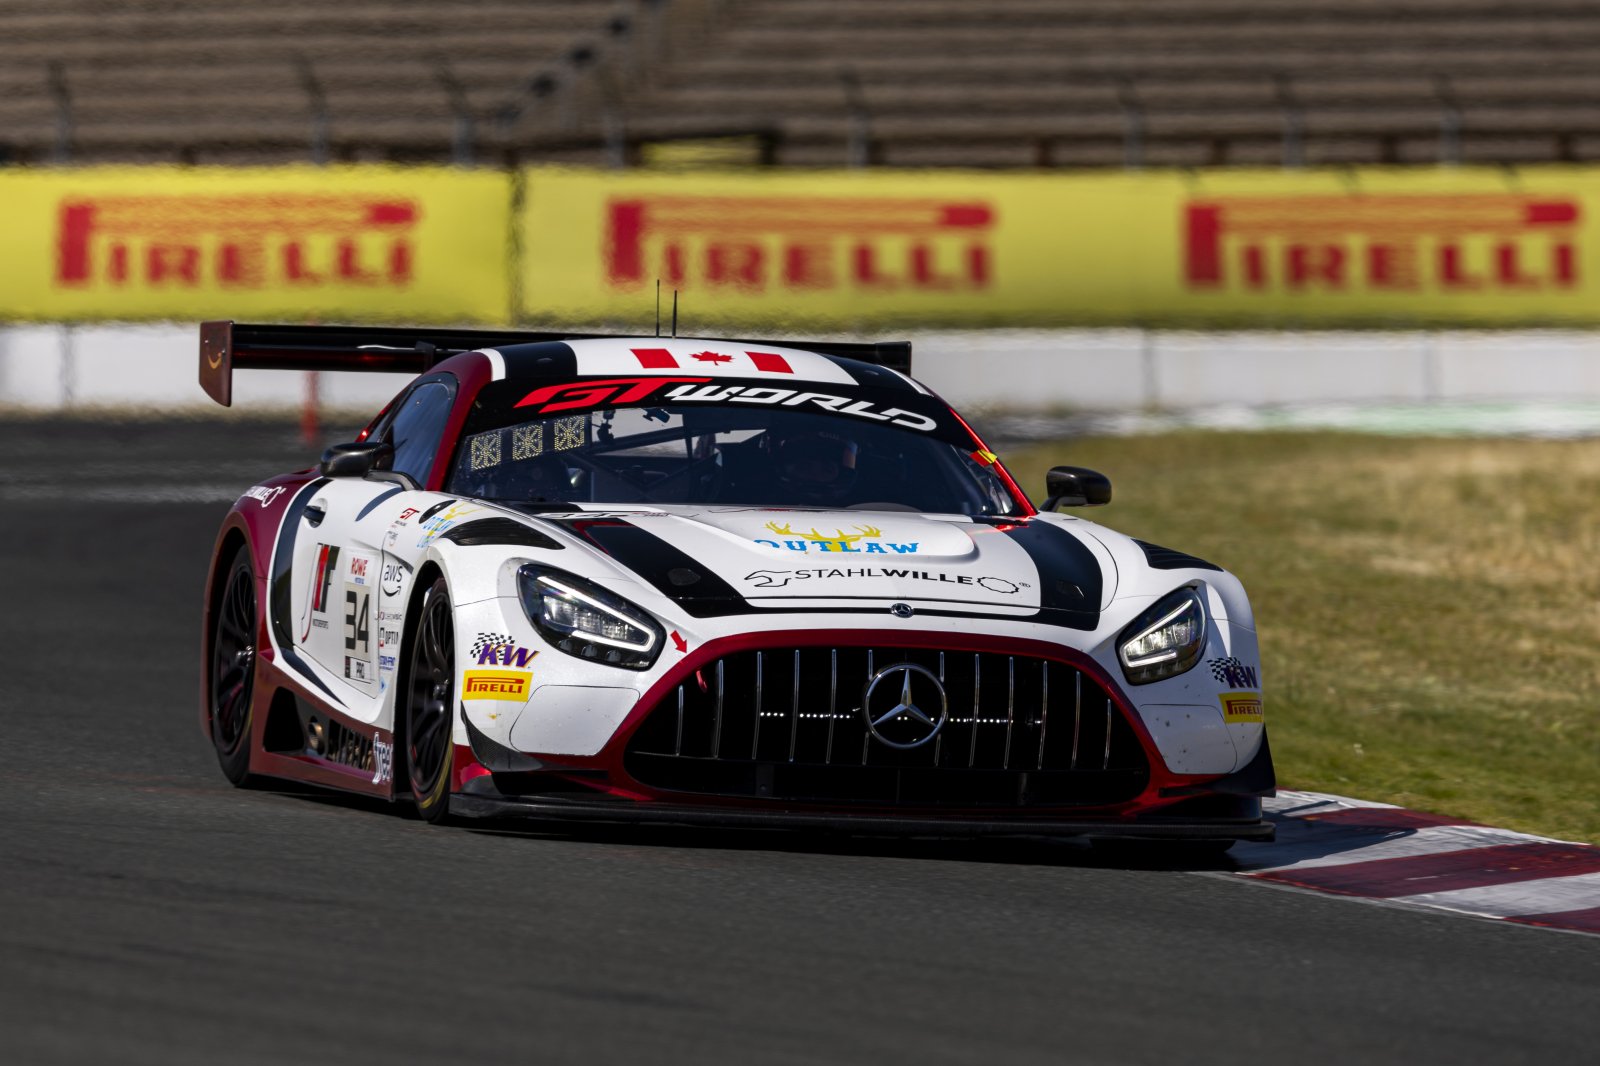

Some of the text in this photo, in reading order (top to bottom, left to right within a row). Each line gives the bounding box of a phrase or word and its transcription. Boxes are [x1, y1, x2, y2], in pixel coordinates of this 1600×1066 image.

[57, 194, 421, 288] PIRELLI
[606, 196, 998, 288] PIRELLI
[1183, 196, 1580, 290] PIRELLI
[351, 556, 369, 577] ROWE
[384, 564, 403, 583] aws
[795, 568, 973, 586] STAHLWILLE
[345, 590, 370, 654] 34
[477, 643, 540, 668] KW
[465, 676, 525, 694] PIRELLI
[1223, 665, 1259, 688] KW
